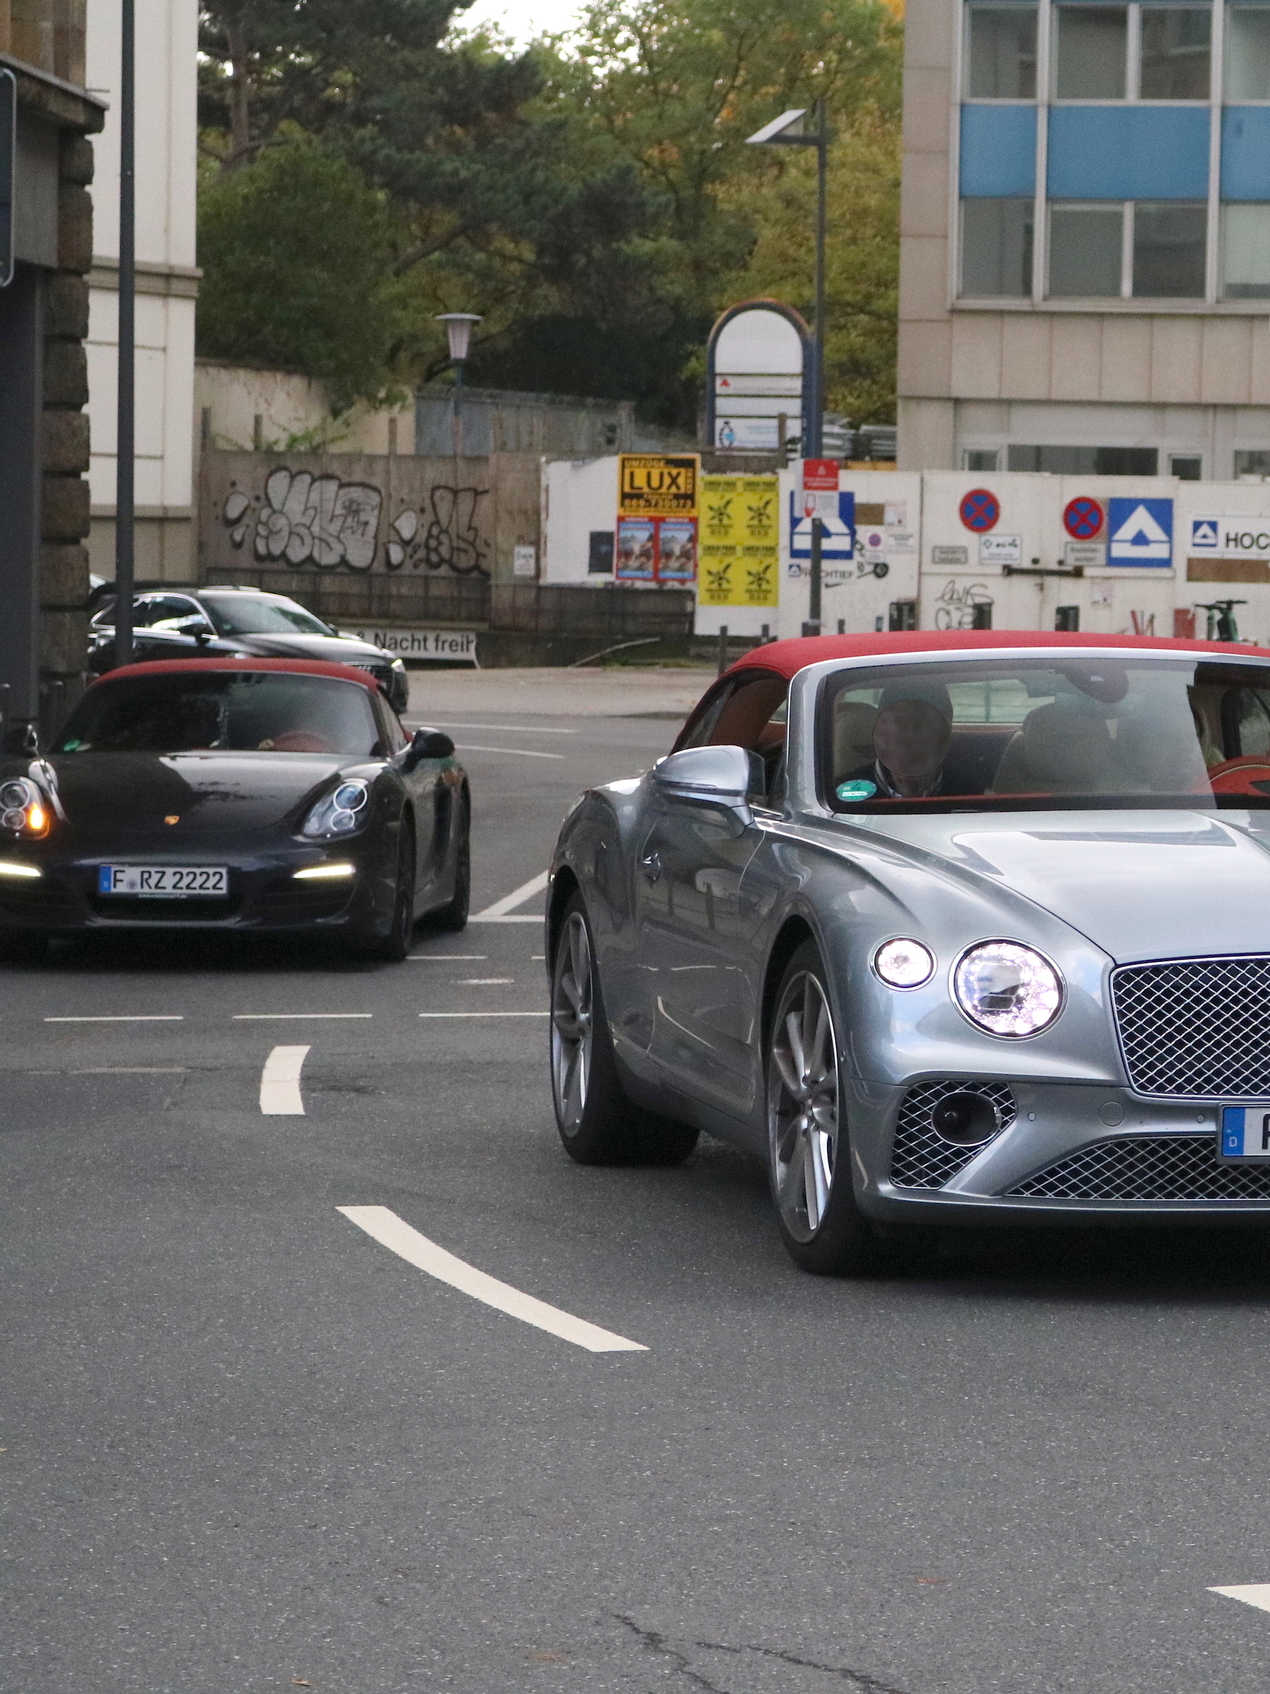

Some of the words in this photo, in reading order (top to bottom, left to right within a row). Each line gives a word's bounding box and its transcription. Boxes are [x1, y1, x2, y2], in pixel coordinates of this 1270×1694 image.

[629, 471, 681, 490] LUX
[374, 631, 428, 652] Nacht
[113, 869, 126, 889] F
[140, 870, 167, 890] RZ
[172, 871, 224, 891] 2222
